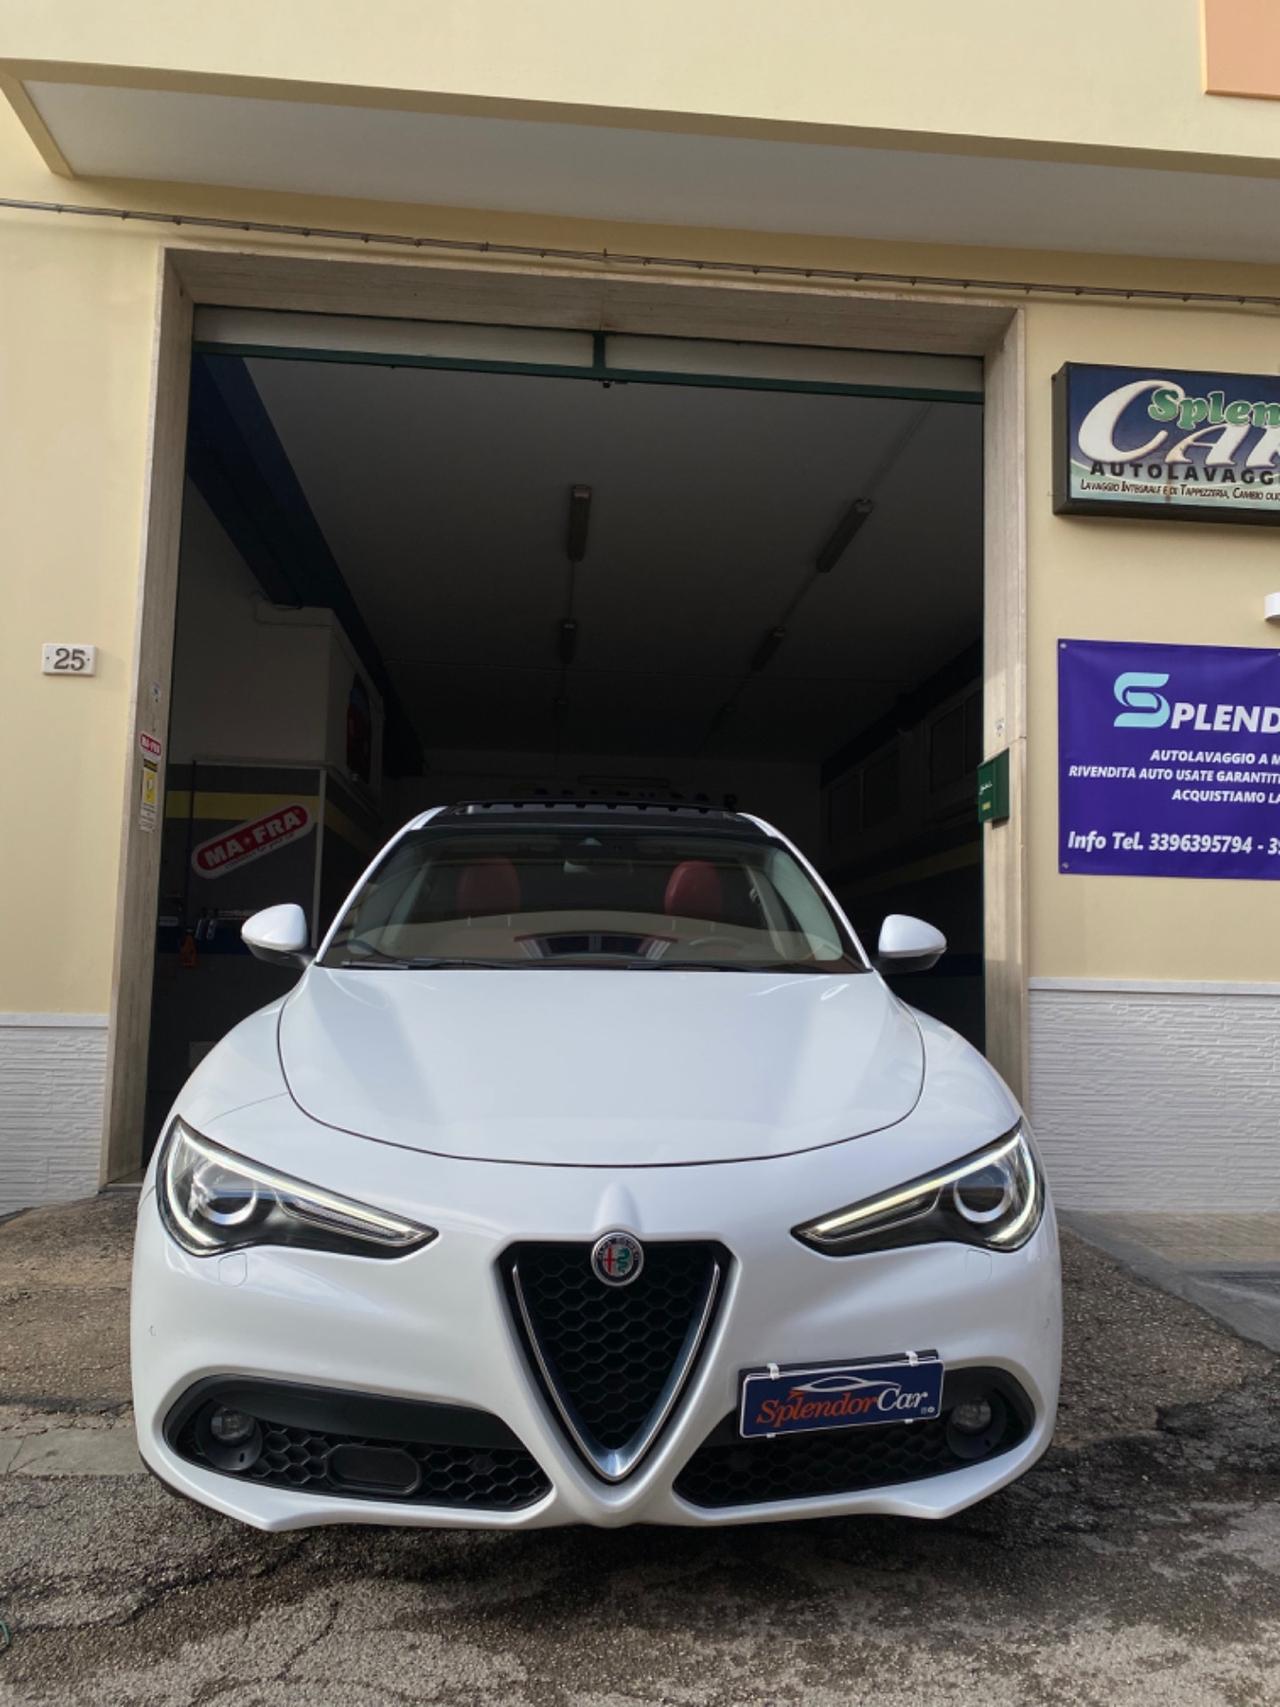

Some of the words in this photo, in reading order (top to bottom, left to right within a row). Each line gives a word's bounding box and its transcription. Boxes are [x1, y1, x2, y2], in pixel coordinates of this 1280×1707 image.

[1148, 390, 1280, 430] Splen
[1090, 461, 1280, 486] AUTOLAVAGG
[53, 647, 86, 671] 25
[1150, 750, 1256, 765] AUTOLAVAGGIO
[1258, 753, 1268, 765] A
[1069, 765, 1136, 779] RIVENDITA
[1139, 768, 1173, 780] AUTO
[1175, 769, 1214, 782] USATE
[1172, 789, 1266, 803] ACQUISTIAMO
[1067, 831, 1106, 852] Info
[1112, 832, 1144, 850] Tel.
[1149, 833, 1253, 853] 3396395794
